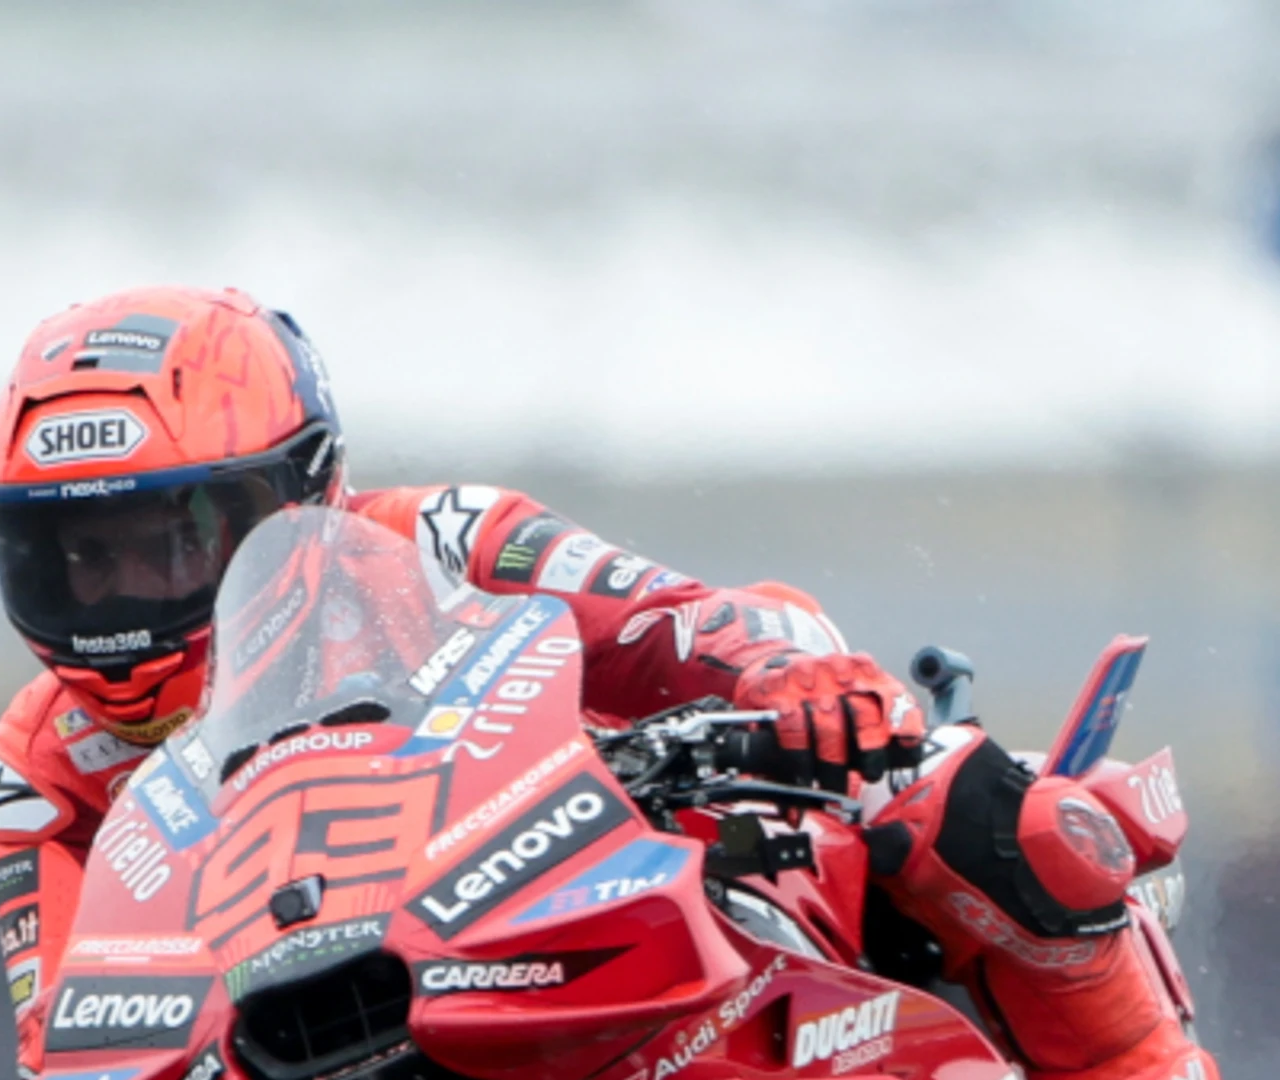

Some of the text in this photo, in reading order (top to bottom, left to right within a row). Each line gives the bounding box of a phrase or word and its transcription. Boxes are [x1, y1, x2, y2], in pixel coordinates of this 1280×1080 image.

[86, 329, 162, 351] Lenovo
[39, 418, 127, 457] SHOEI
[72, 629, 152, 653] Insta360
[420, 791, 606, 925] Lenovo
[250, 919, 383, 974] MONSTER
[422, 962, 565, 989] CARRERA
[718, 953, 789, 1030] Sport
[53, 988, 194, 1029] Lenovo
[792, 990, 901, 1069] DUCATI
